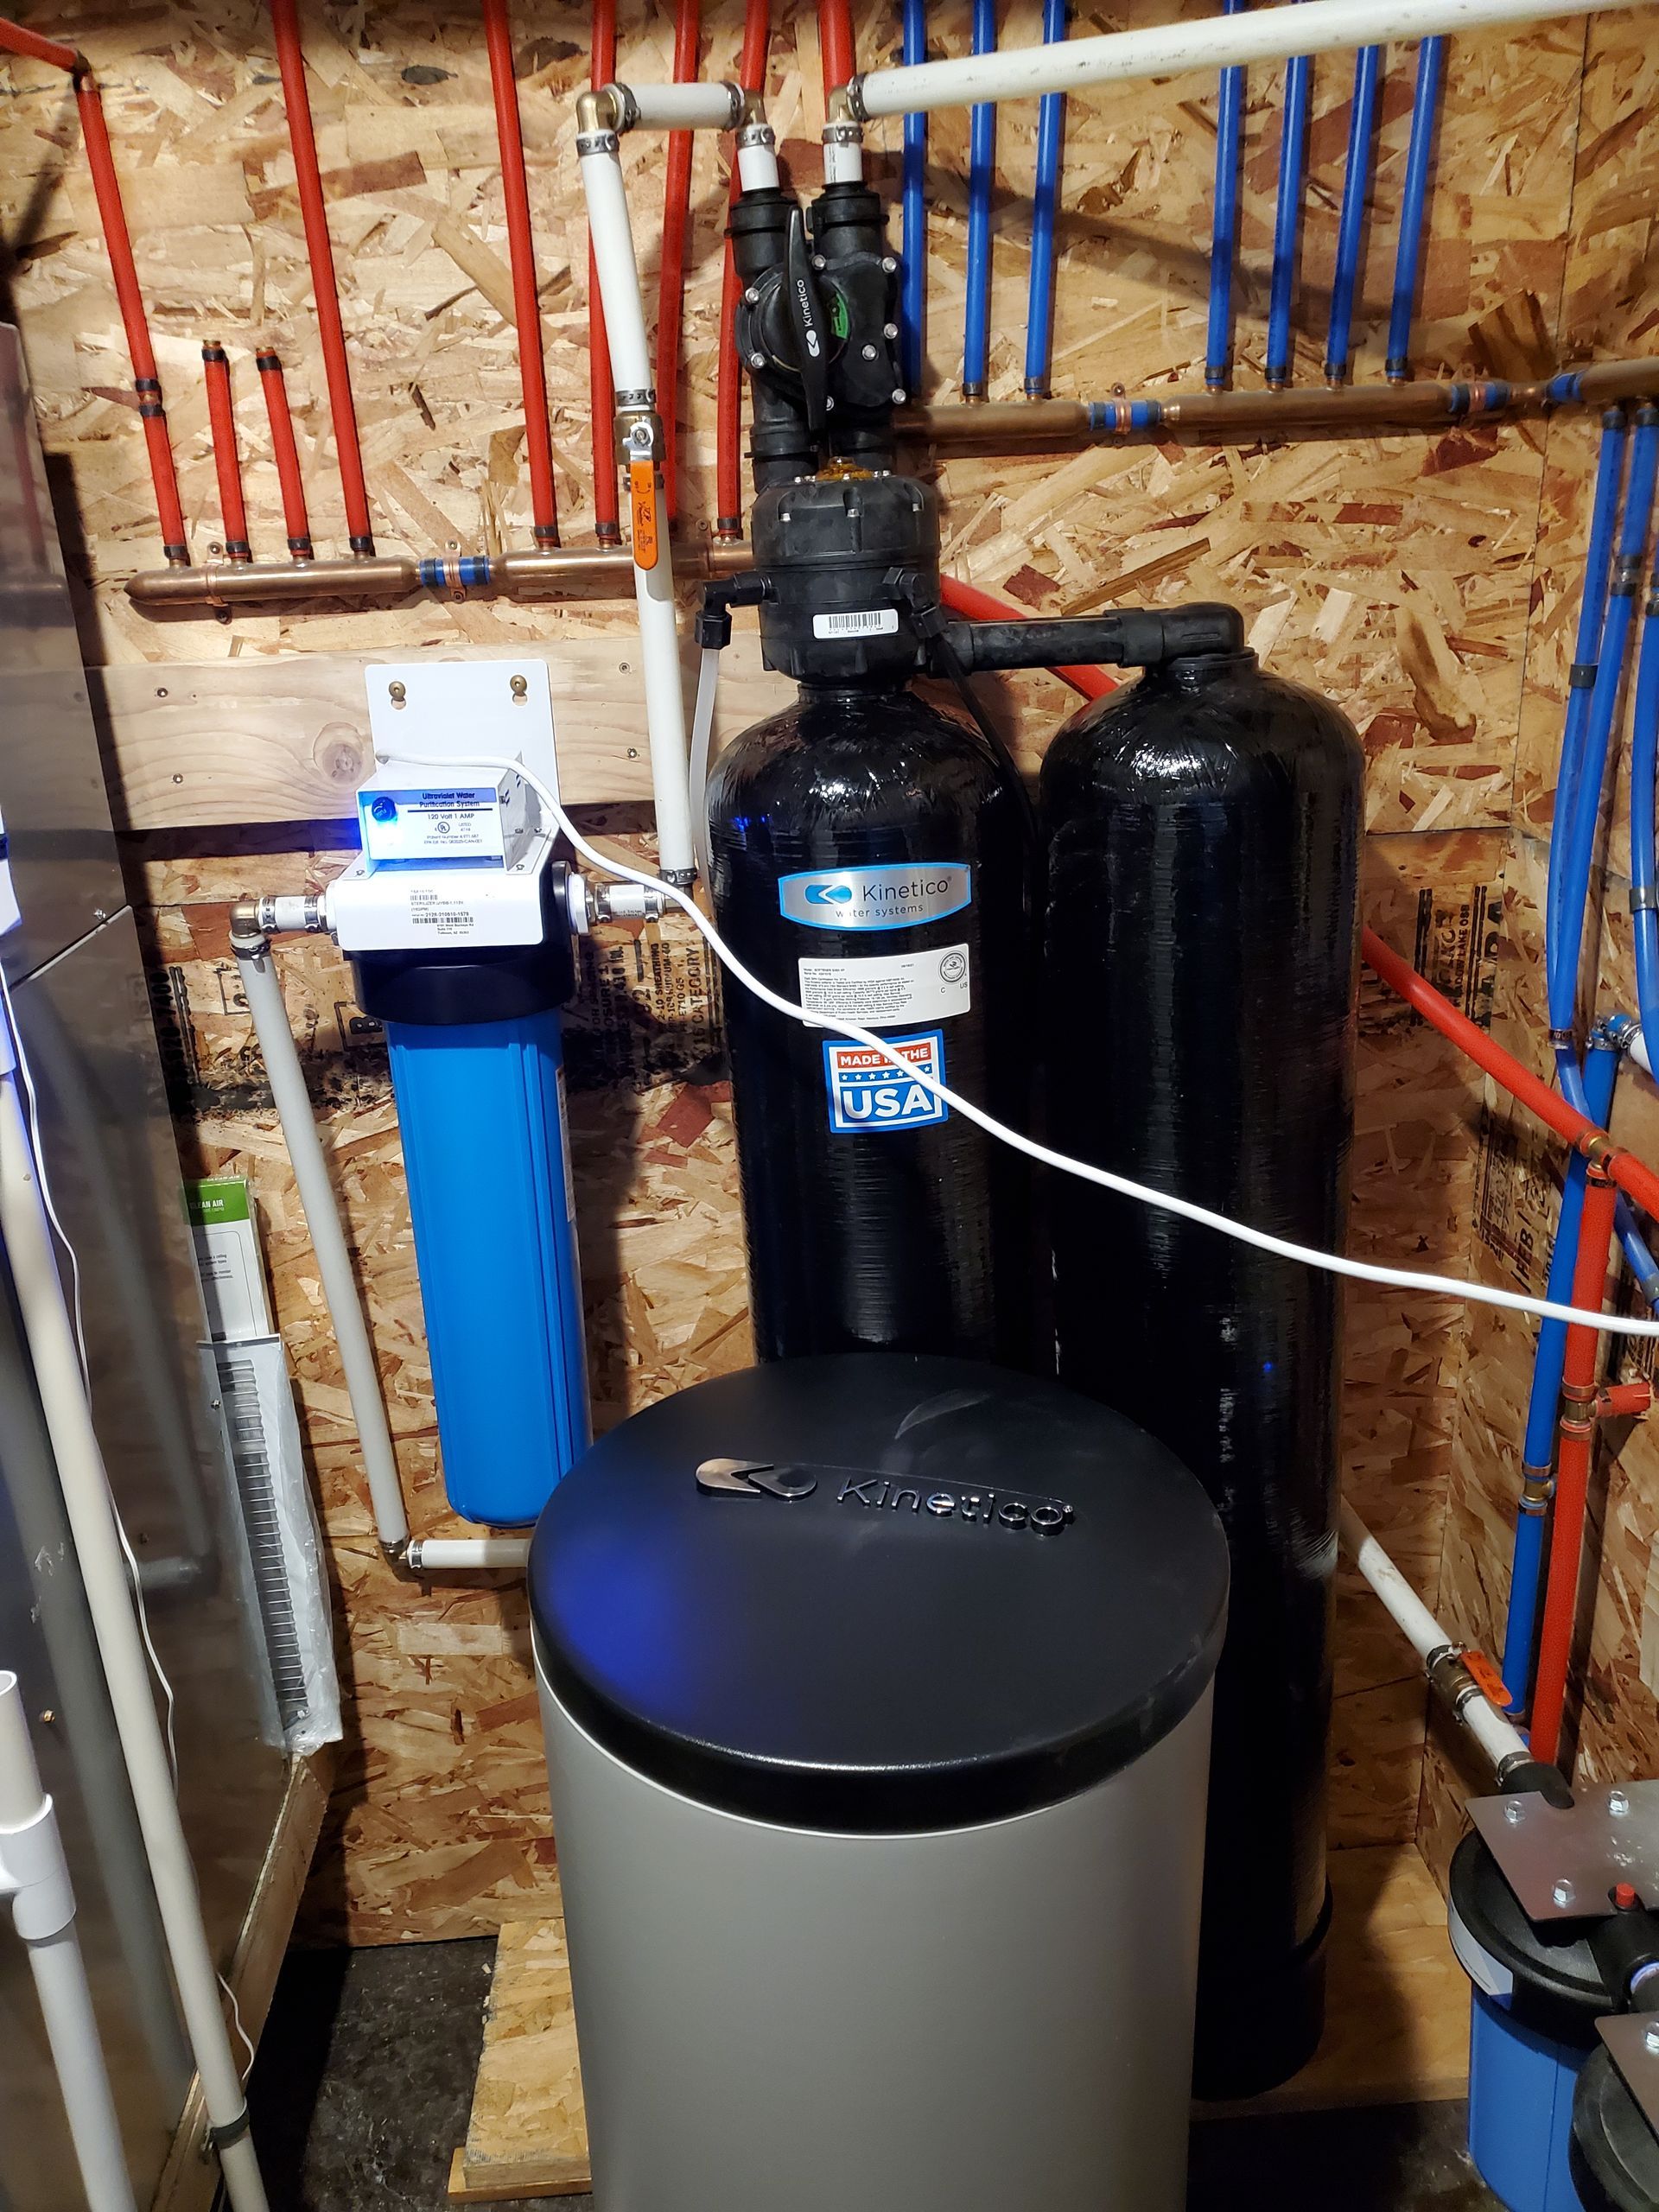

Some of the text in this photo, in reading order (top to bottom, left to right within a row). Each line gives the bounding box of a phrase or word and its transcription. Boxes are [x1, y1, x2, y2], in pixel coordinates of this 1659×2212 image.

[797, 279, 813, 327] Kinetico
[862, 879, 950, 901] Kinetico
[836, 904, 924, 918] wter systems
[1458, 928, 1468, 957] LAKE
[651, 943, 663, 996] SHEATHING
[676, 977, 685, 991] G5
[686, 947, 705, 1023] CATEGORY
[840, 1054, 881, 1066] MADE
[901, 1047, 929, 1060] THE
[842, 1084, 933, 1120] USA
[212, 1198, 224, 1208] AIR
[836, 1478, 1066, 1535] Kinetico
